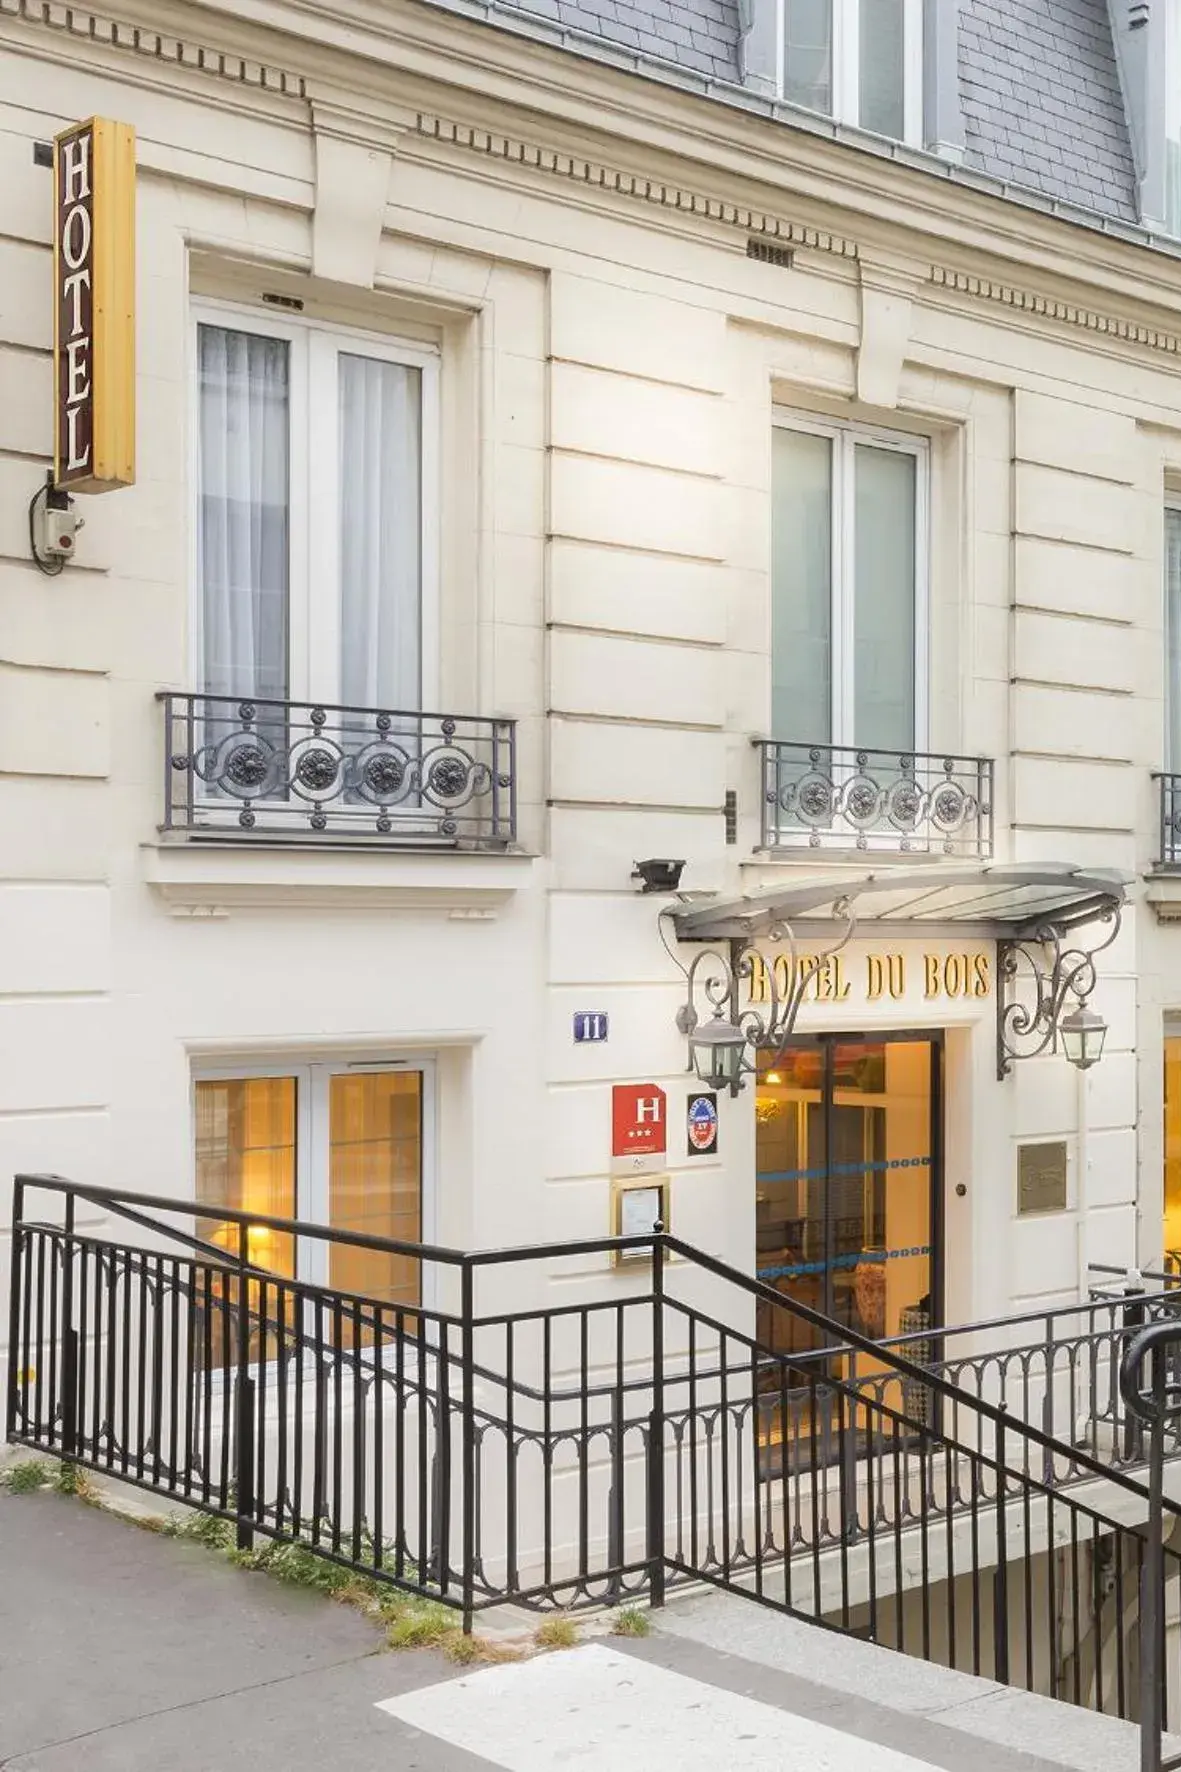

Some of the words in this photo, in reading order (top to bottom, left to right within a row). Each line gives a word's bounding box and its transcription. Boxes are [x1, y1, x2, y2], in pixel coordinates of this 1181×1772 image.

[62, 134, 91, 472] HOTEL
[747, 954, 851, 1003] HOTEL
[866, 953, 906, 1000] DU
[923, 952, 990, 999] BOIS
[581, 1015, 602, 1040] 11
[635, 1097, 661, 1124] H
